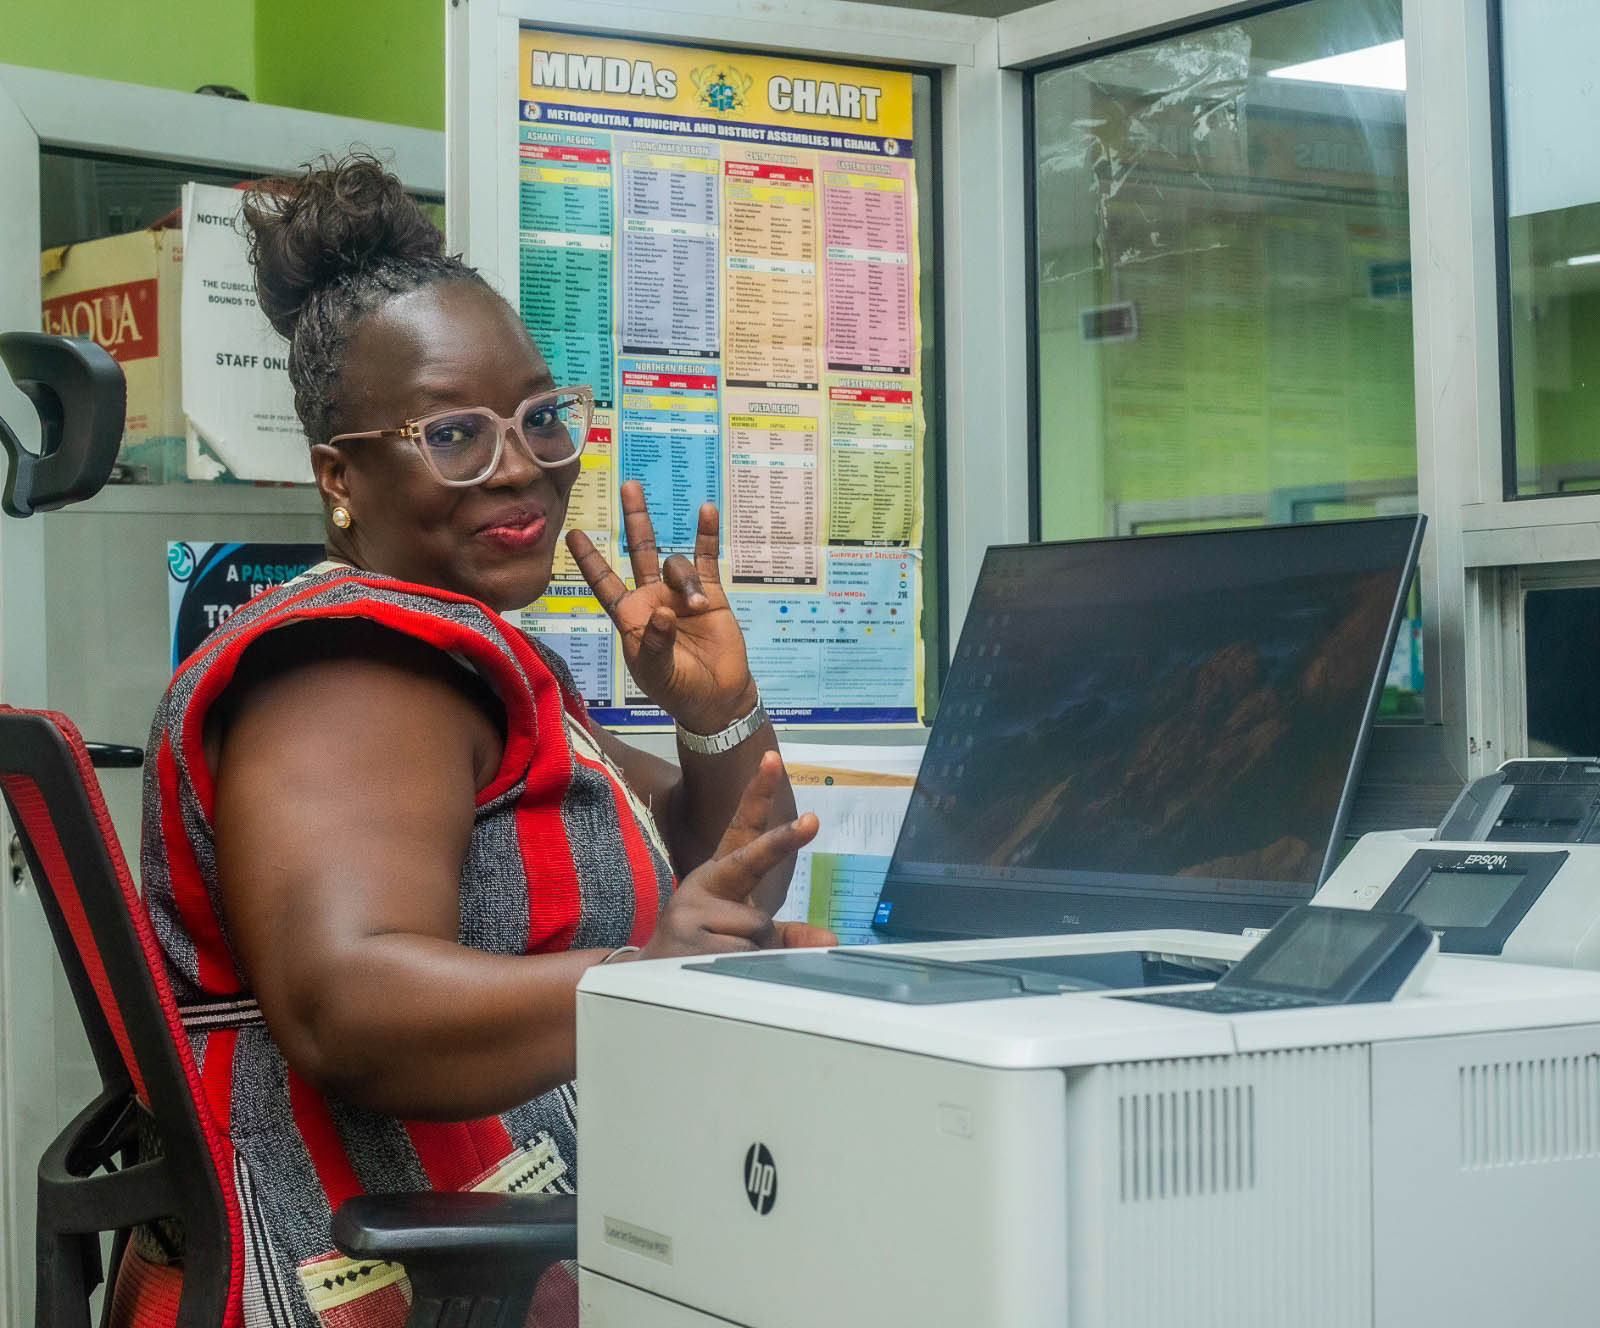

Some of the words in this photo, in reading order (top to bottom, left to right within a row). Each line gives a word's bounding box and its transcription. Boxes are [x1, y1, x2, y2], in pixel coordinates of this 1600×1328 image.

[532, 50, 677, 99] MMDAs
[768, 76, 881, 120] CHART
[547, 109, 631, 128] METROPOLITAN,
[633, 117, 692, 132] MUNICIPAL
[694, 124, 716, 134] AND
[718, 125, 765, 139] DISTRICT
[767, 130, 829, 146] ASSEMBLIES
[831, 137, 842, 146] IN
[528, 131, 561, 143] ASHANTI
[566, 135, 595, 146] REGION
[202, 280, 218, 288] THE
[208, 295, 242, 306] BOUNDS
[246, 298, 256, 307] TO
[216, 352, 258, 368] STAFF
[636, 362, 676, 373] NORTHERN
[678, 365, 706, 375] REGION
[226, 564, 239, 582] A
[555, 586, 576, 595] WEST
[1464, 854, 1507, 865] EPSON
[748, 1142, 775, 1214] hp
